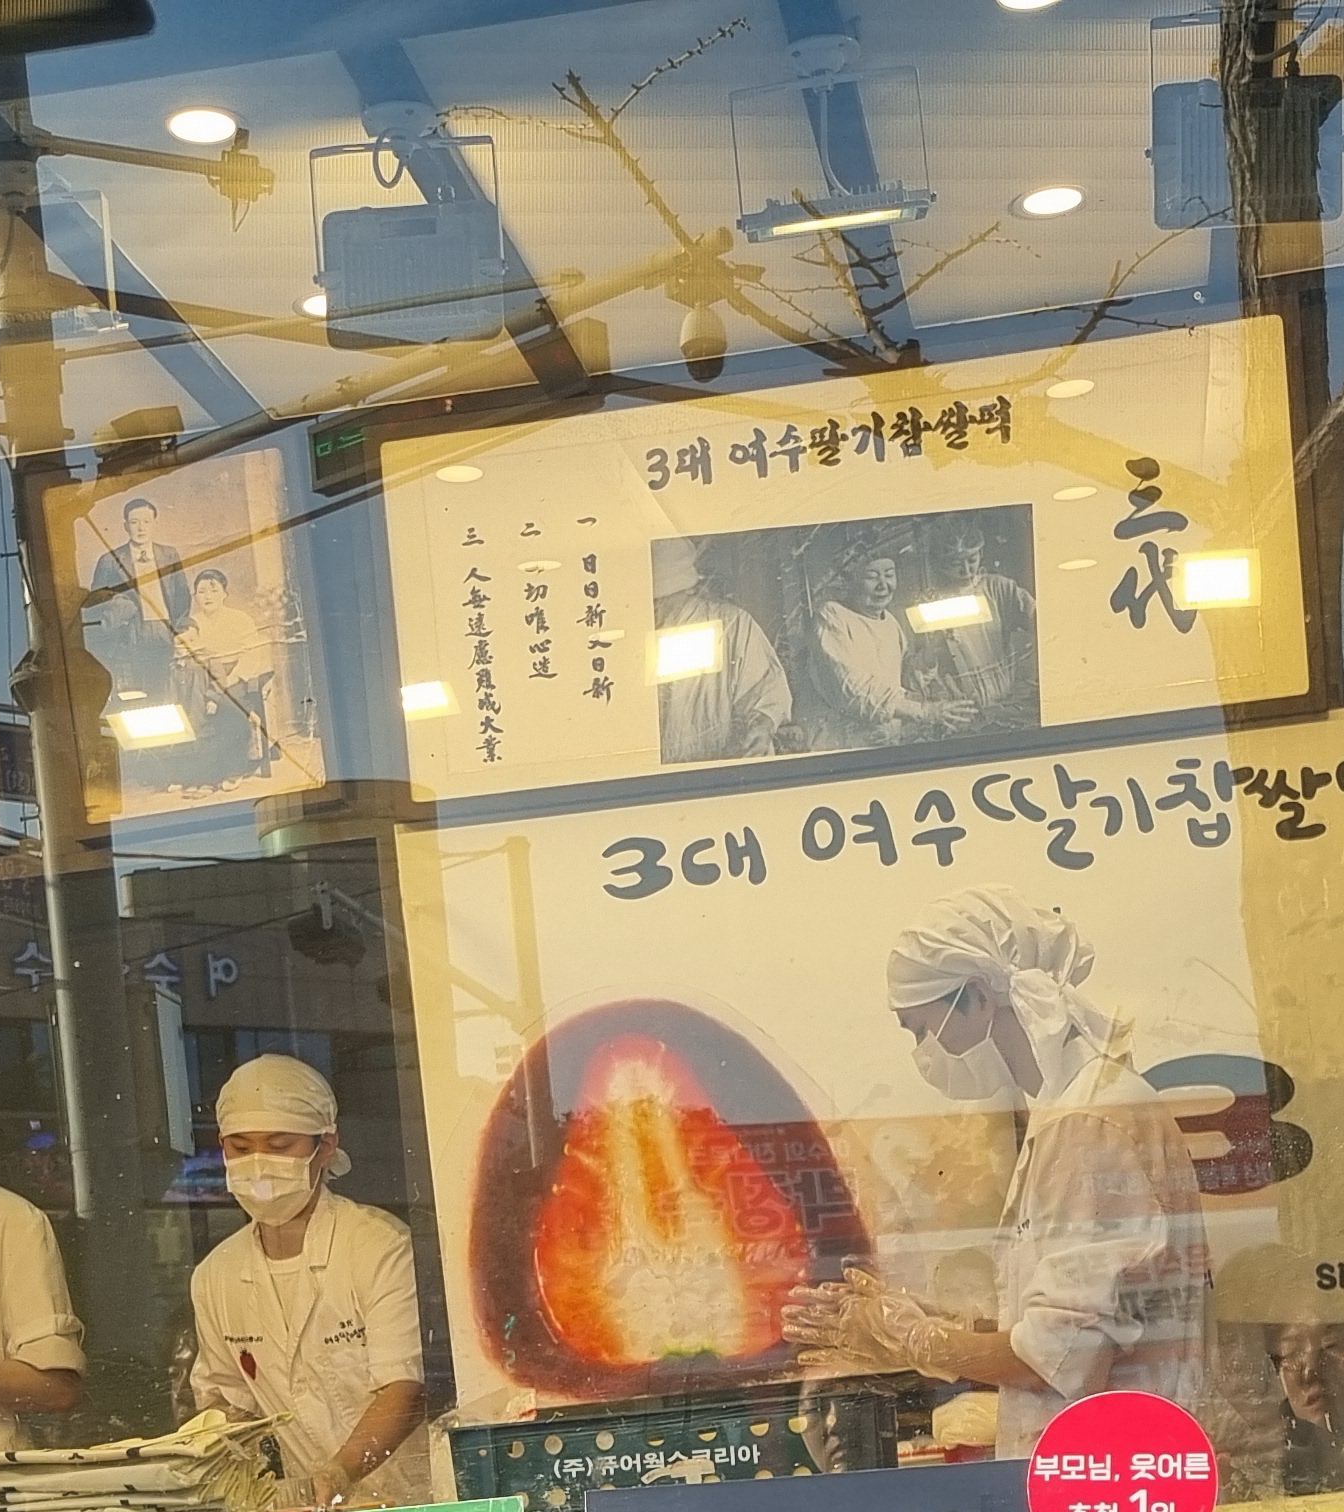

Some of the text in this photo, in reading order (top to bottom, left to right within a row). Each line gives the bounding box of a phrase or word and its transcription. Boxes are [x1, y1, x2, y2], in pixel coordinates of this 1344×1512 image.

[646, 437, 713, 491] 3대
[1108, 457, 1199, 632] 三代
[602, 824, 769, 900] 3대
[1034, 1451, 1212, 1483] 부모님, 웃어른
